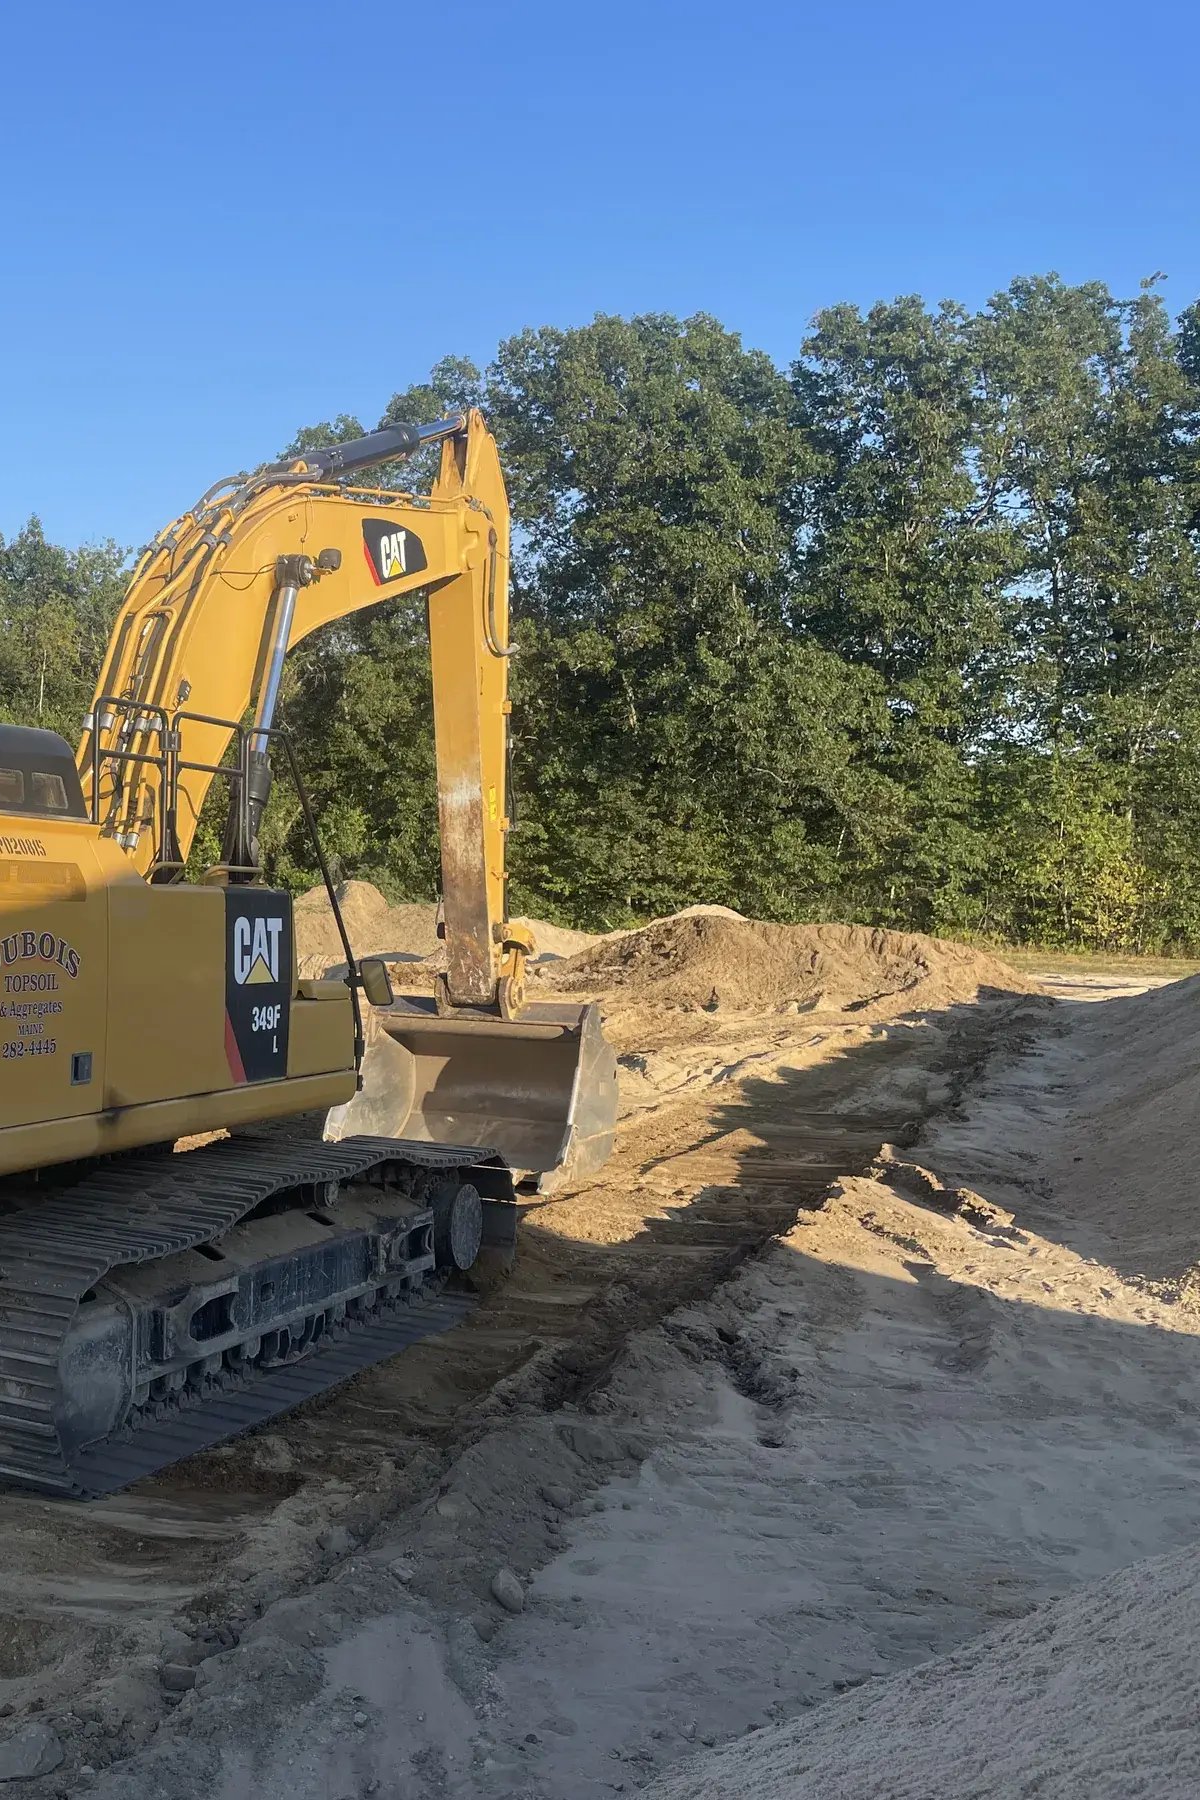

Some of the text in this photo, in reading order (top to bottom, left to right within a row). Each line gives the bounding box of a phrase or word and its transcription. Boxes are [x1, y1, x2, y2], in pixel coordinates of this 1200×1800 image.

[380, 530, 407, 579] CAT
[234, 916, 283, 985] CAT
[4, 973, 59, 993] TOPSOIL
[0, 1000, 63, 1020] & Aggregates
[251, 1003, 281, 1032] 349F
[17, 1023, 44, 1036] MAINE
[2, 1038, 57, 1059] 282-4445
[272, 1035, 278, 1053] L
